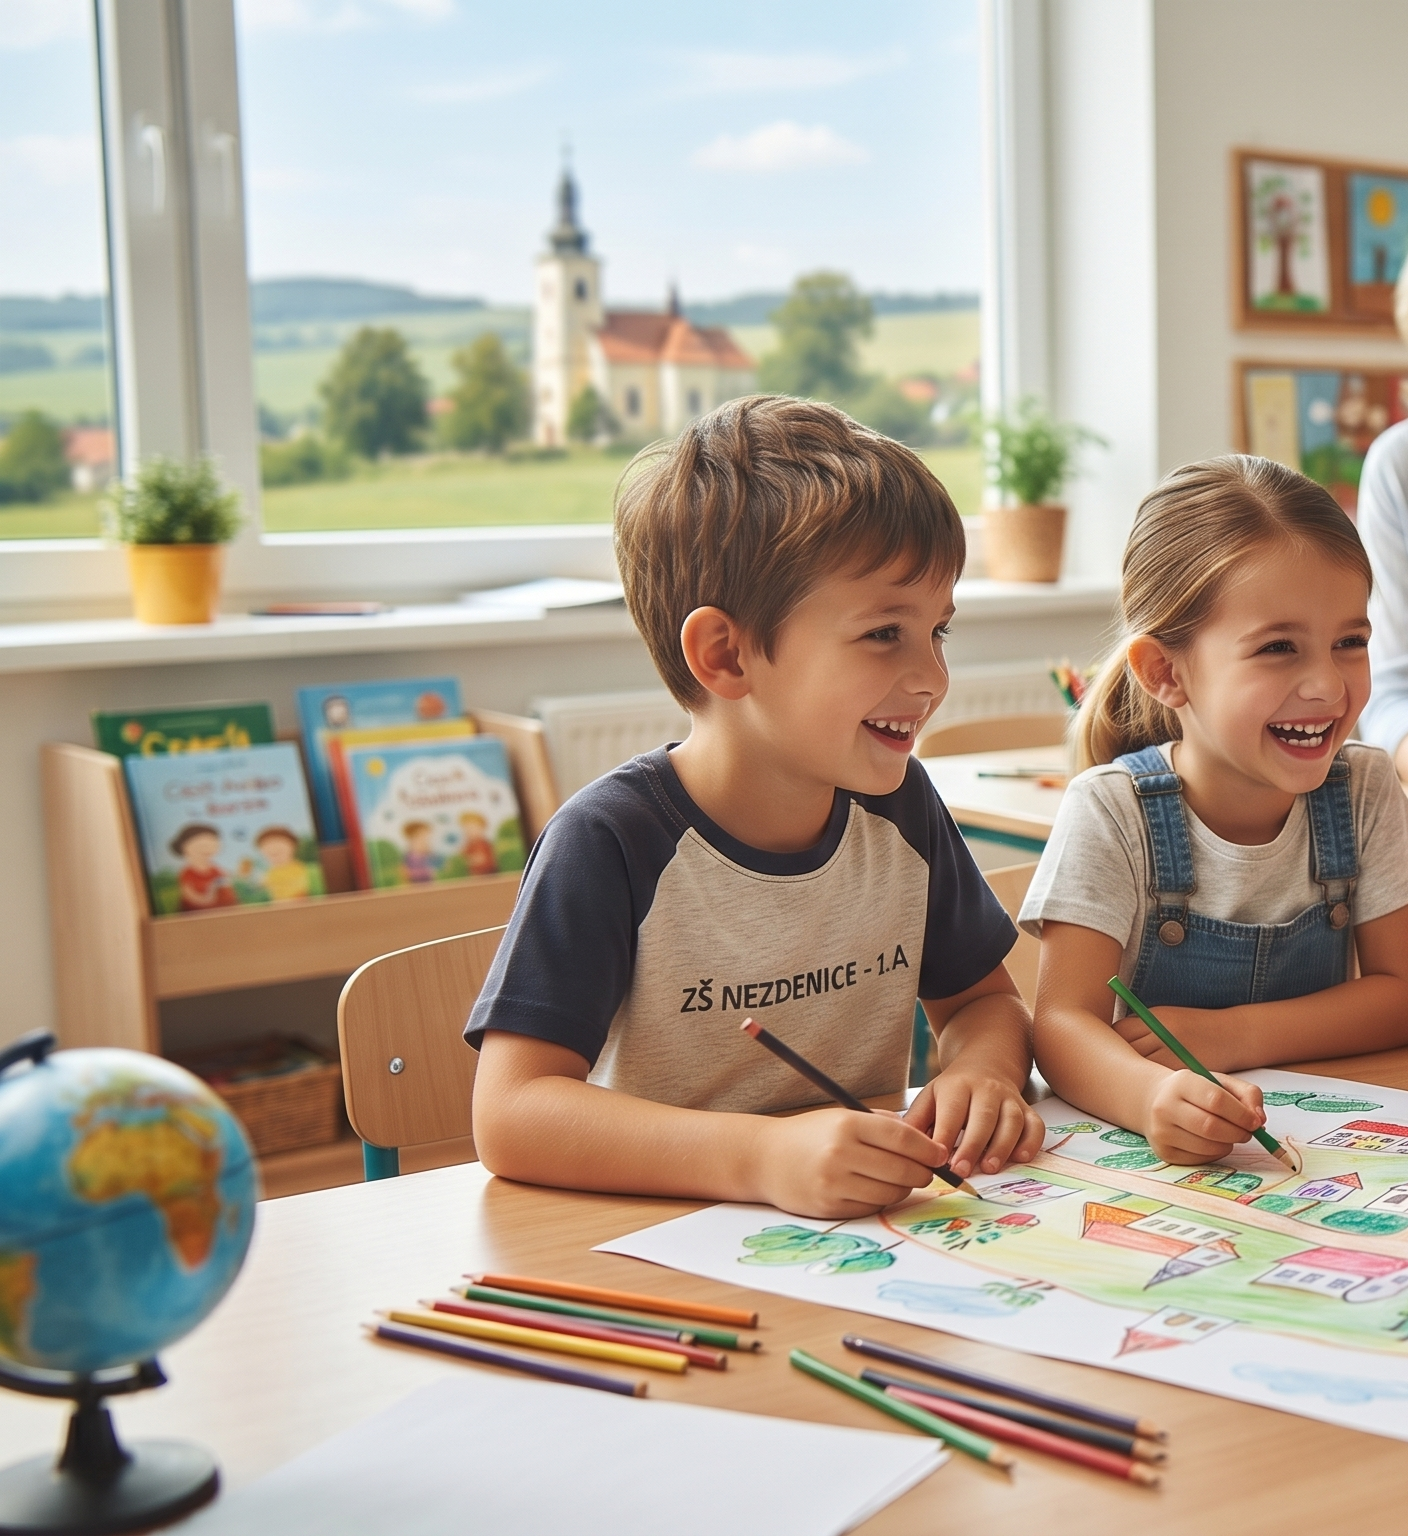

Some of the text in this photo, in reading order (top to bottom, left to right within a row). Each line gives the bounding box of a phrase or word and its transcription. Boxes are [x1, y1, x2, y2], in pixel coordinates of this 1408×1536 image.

[680, 944, 910, 1013] ZŠ NEZDENICE - 1.A
